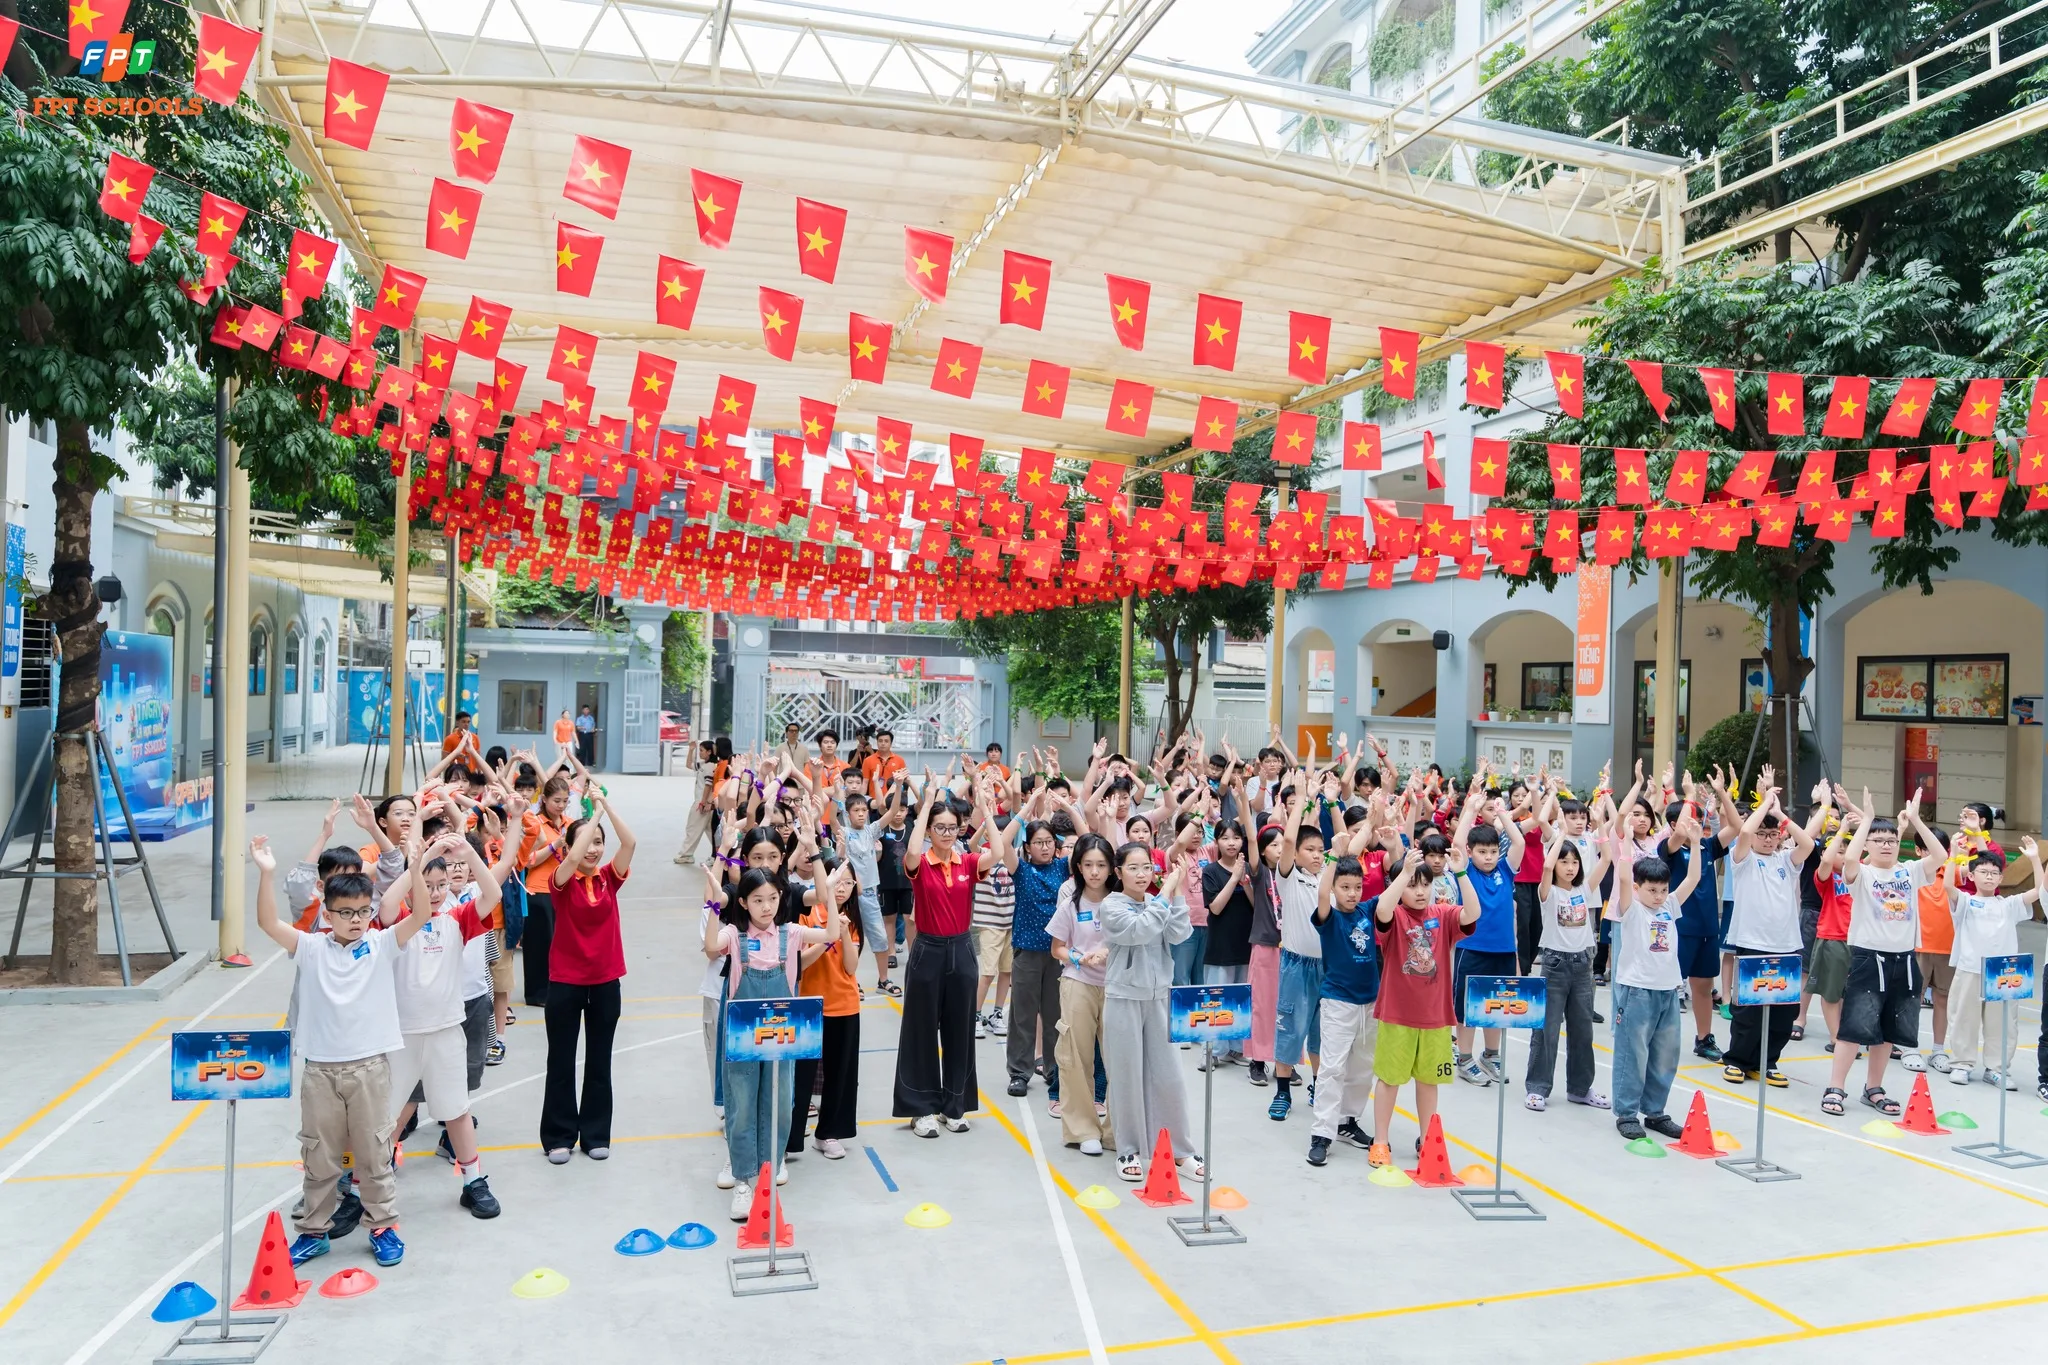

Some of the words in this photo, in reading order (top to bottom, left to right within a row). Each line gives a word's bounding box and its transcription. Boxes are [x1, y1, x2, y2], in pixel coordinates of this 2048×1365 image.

[1579, 643, 1600, 664] TIẾNG
[1578, 668, 1595, 684] ANH
[175, 779, 198, 807] OPEN
[1752, 976, 1787, 992] F14
[1485, 999, 1528, 1014] F13
[1189, 1010, 1234, 1027] F12
[754, 1026, 796, 1045] F11
[216, 1049, 247, 1058] LỚP
[197, 1061, 266, 1082] F10
[1437, 1062, 1452, 1077] 56
